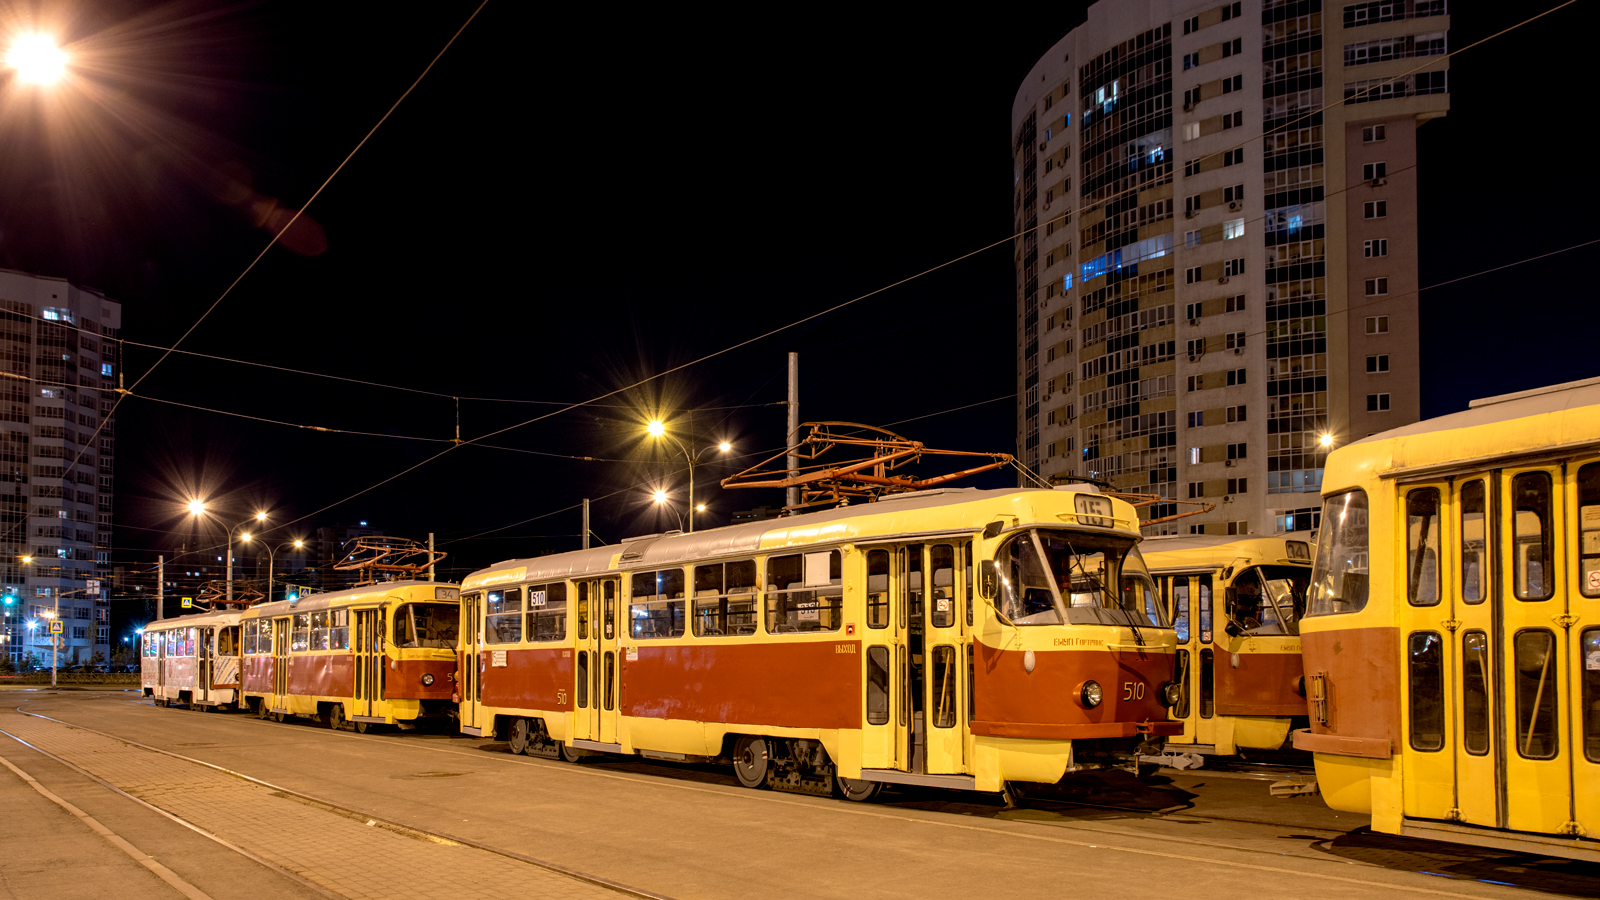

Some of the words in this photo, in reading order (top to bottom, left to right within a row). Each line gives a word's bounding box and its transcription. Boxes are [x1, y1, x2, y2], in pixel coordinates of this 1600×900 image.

[1081, 500, 1104, 525] 15
[1287, 544, 1305, 560] 34
[441, 590, 453, 600] 34
[532, 592, 544, 605] 510
[835, 643, 857, 654] ВЫХОД
[1123, 681, 1145, 701] 510
[557, 692, 568, 705] 510
